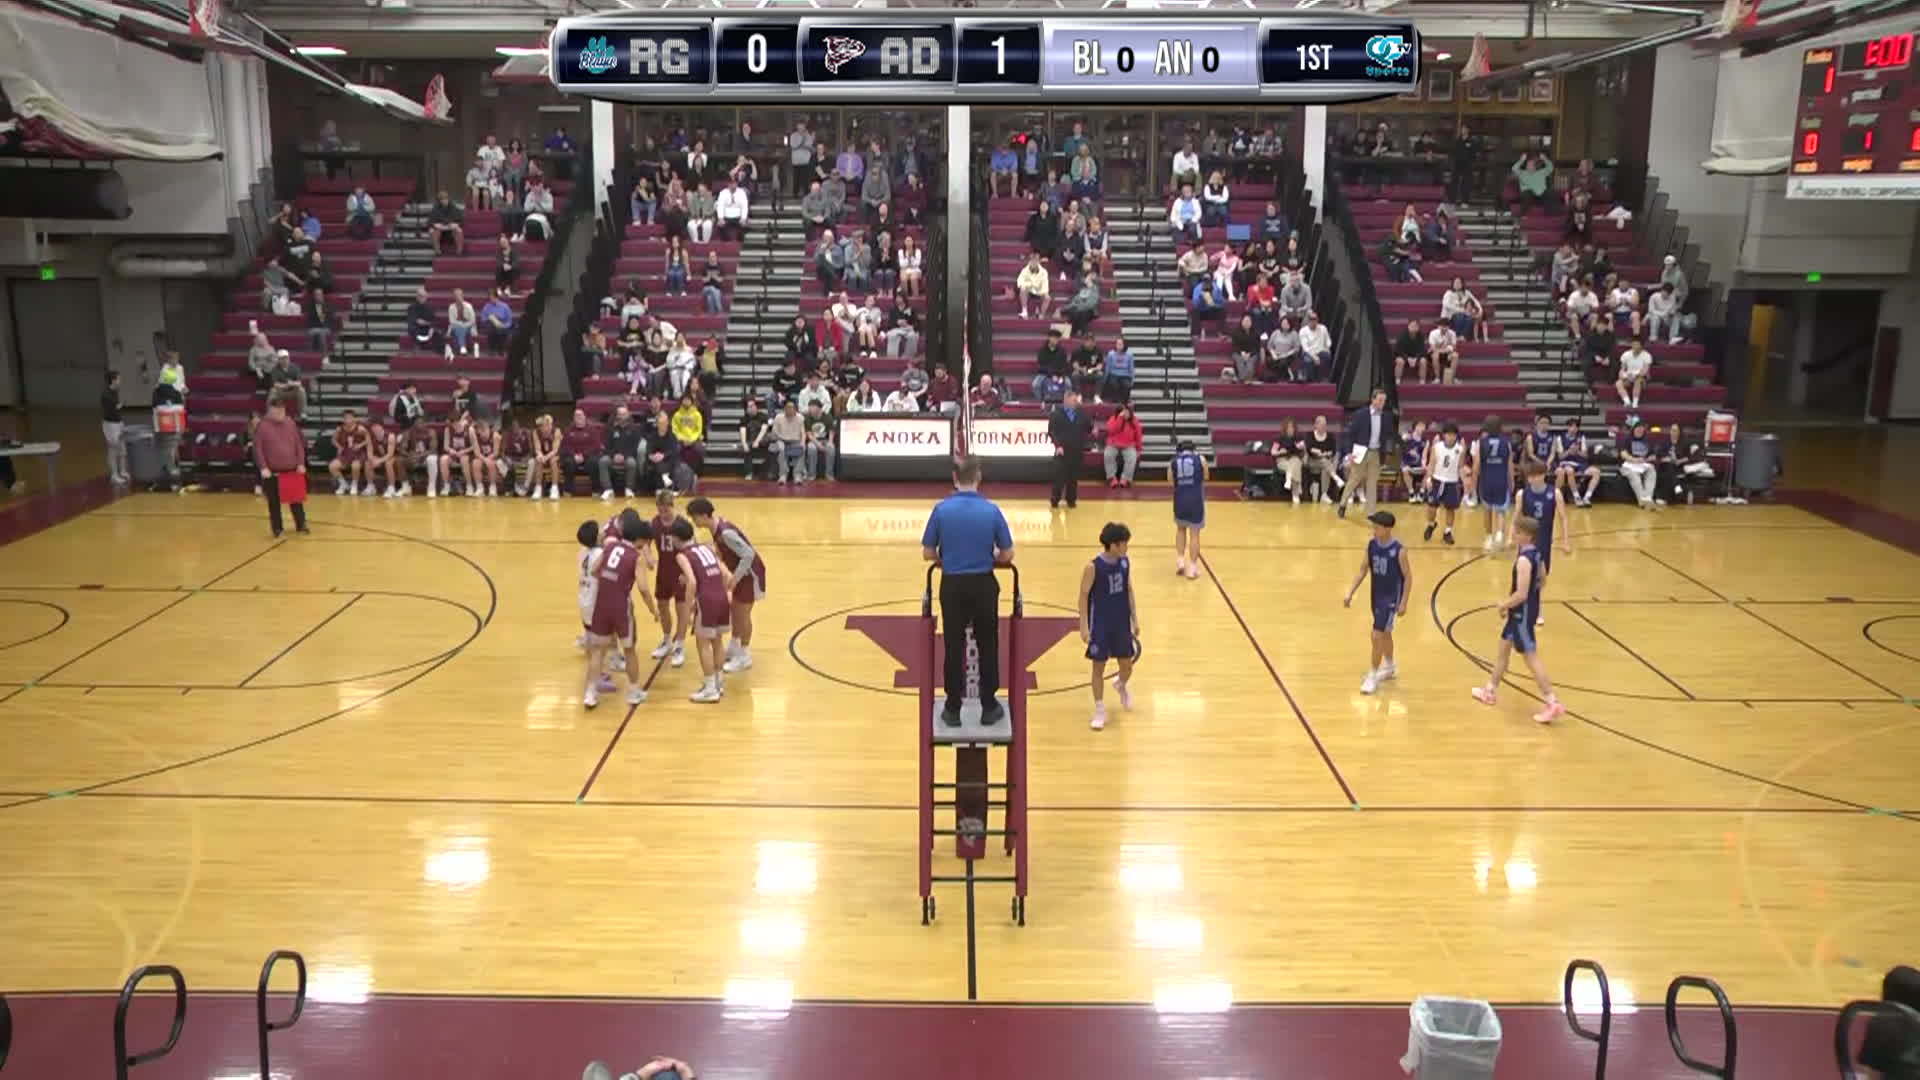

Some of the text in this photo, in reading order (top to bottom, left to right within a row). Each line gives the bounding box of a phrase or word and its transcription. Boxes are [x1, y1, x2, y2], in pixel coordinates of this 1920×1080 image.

[865, 431, 1055, 445] ANOKA TORNADO
[607, 546, 625, 569] 6
